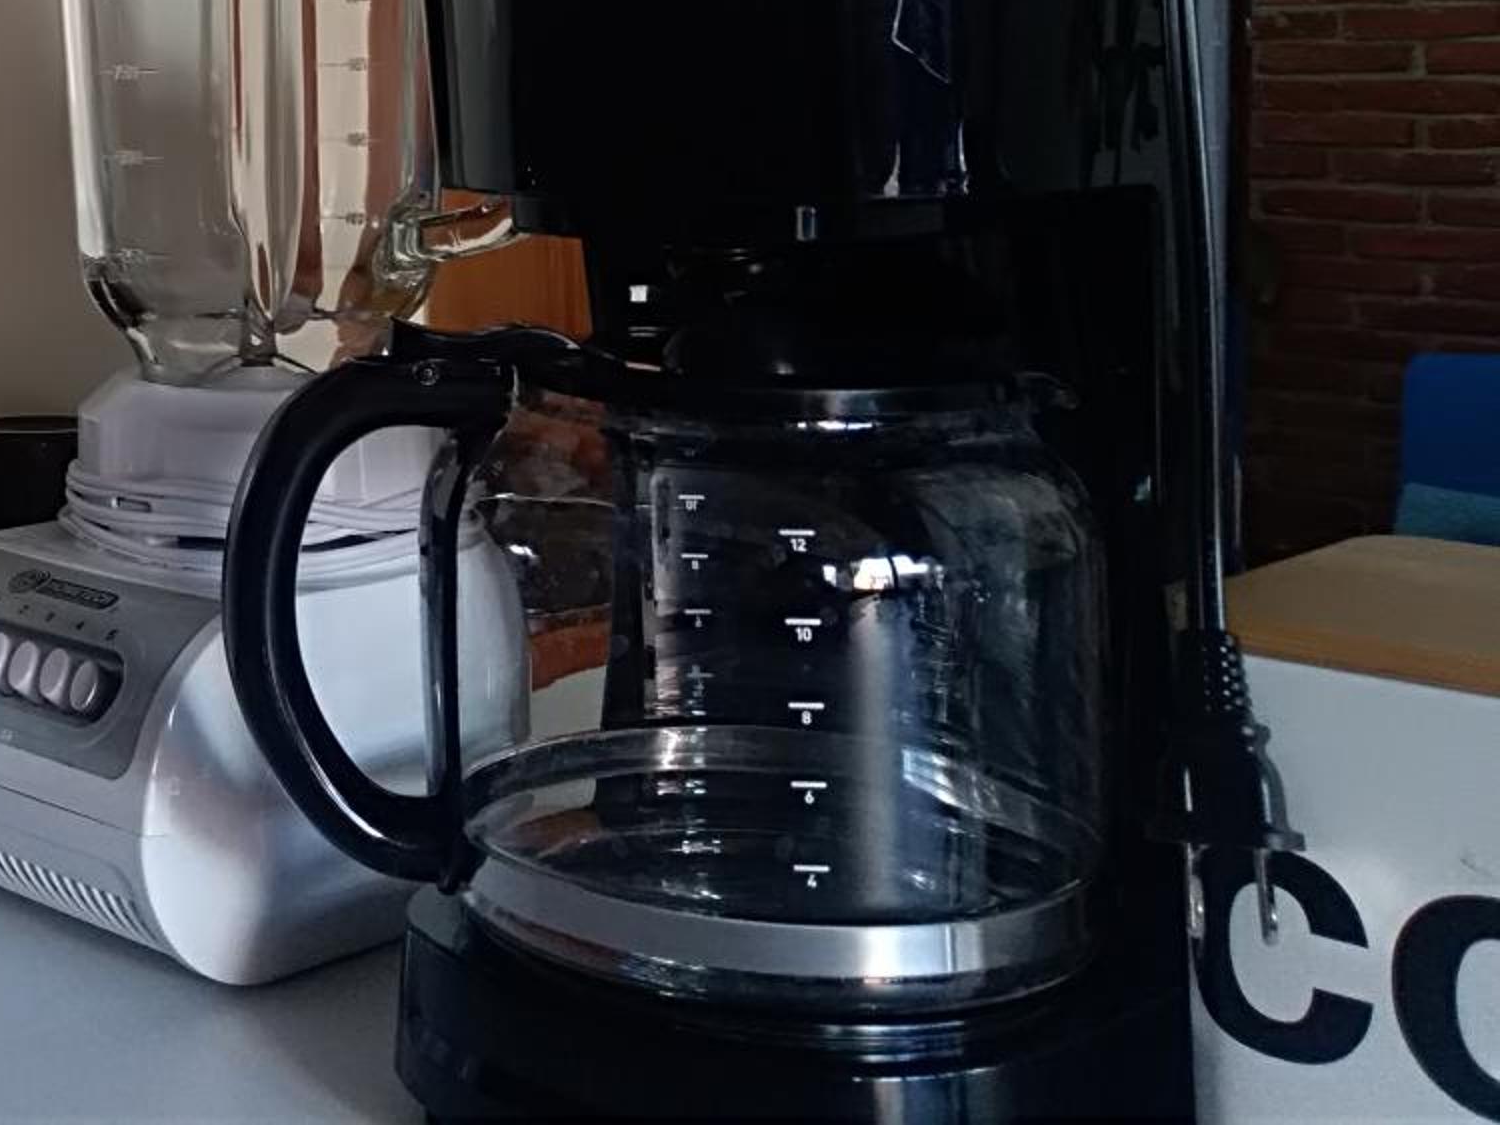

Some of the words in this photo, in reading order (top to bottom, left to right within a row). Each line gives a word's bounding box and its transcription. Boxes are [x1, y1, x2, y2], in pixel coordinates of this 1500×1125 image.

[790, 539, 807, 552] 12
[795, 627, 813, 642] 10
[801, 711, 812, 725] 8
[804, 790, 815, 804] 6
[807, 875, 818, 889] 4
